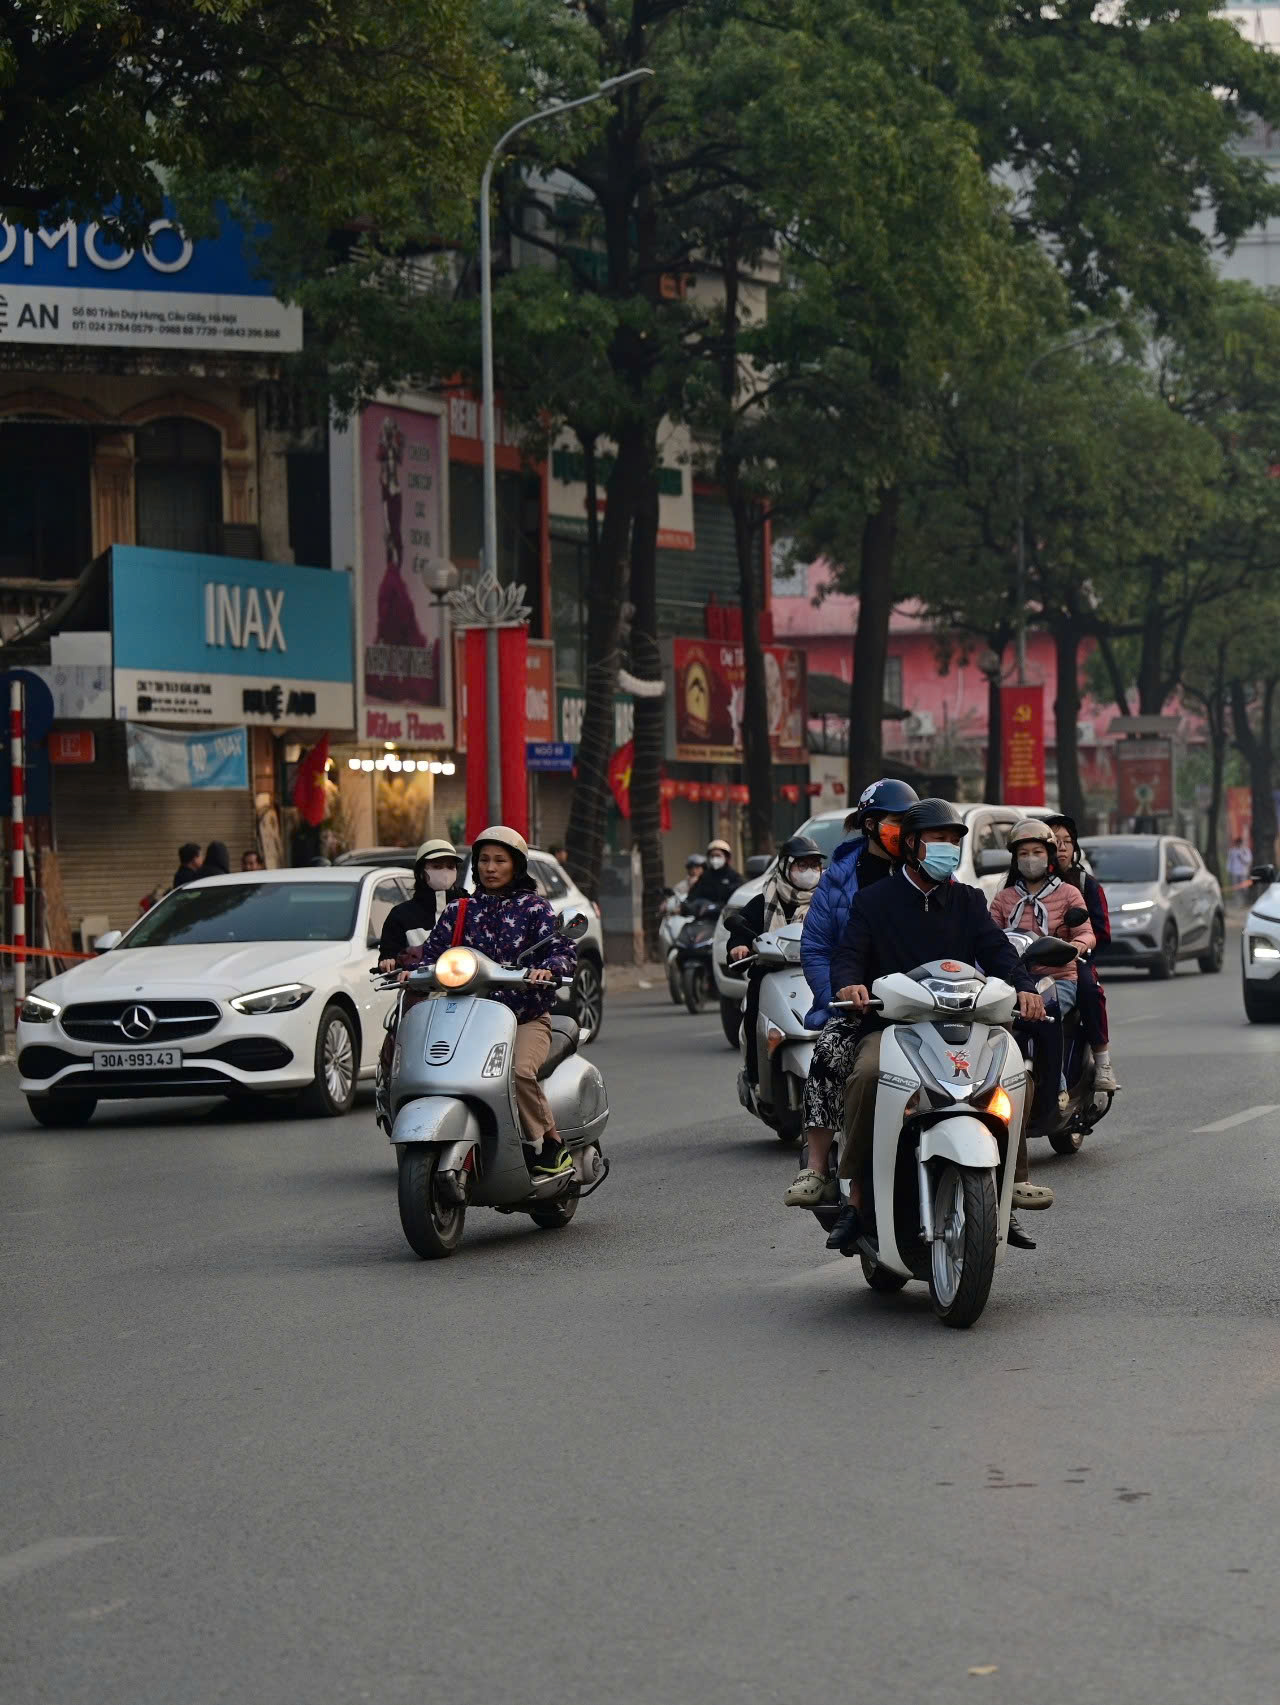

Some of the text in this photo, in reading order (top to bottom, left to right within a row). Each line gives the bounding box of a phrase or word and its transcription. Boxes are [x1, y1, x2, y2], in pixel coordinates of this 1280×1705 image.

[17, 303, 59, 329] AN
[121, 308, 137, 321] Duy
[89, 322, 105, 331] 024
[205, 581, 286, 652] INAX
